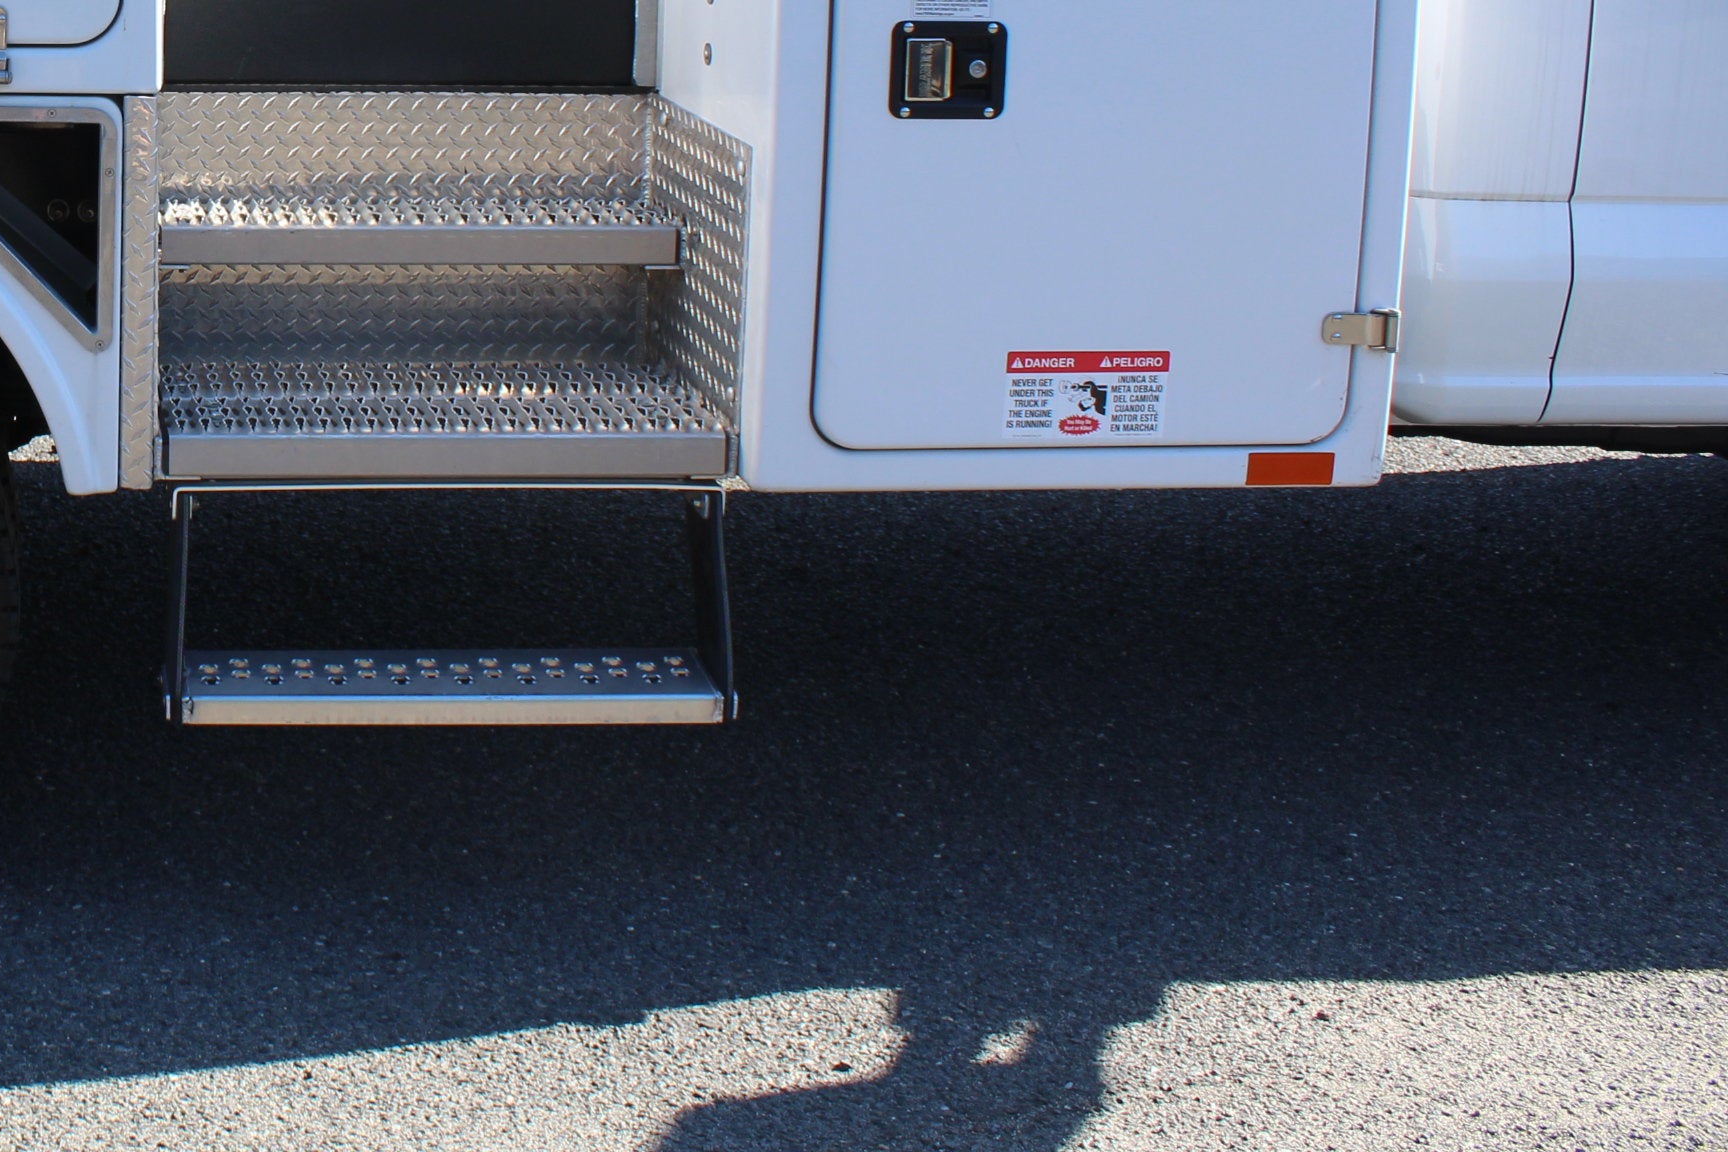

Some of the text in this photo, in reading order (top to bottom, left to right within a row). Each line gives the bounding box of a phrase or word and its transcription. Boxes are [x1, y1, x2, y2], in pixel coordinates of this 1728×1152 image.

[1024, 358, 1074, 368] DANGER
[1113, 357, 1163, 367] PELIGRO
[1012, 379, 1036, 387] NEVER
[1009, 389, 1035, 397] UNDER
[1111, 385, 1162, 393] META DEBAJO
[1129, 393, 1159, 402] CAMIÓN
[1014, 399, 1048, 407] TRUCK IF
[1008, 410, 1022, 418] THE
[1111, 412, 1158, 422] MOTOR ESTÉ
[1006, 420, 1052, 428] IS RUNNING!
[1110, 424, 1157, 432] EN MARCHA!
